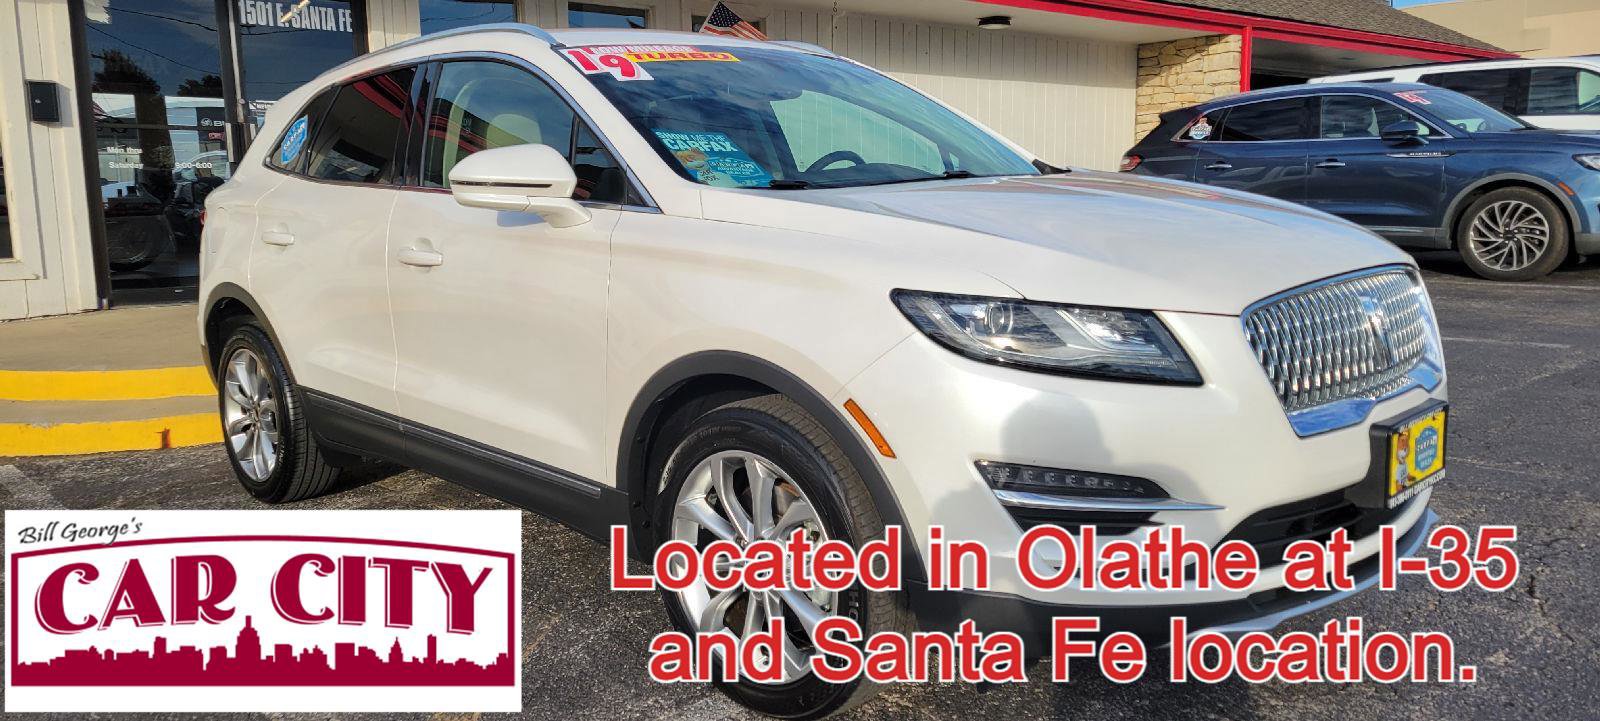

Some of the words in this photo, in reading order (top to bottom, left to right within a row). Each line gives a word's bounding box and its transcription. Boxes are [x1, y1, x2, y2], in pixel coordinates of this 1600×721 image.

[239, 0, 274, 26] 1501
[291, 4, 337, 31] SANTA
[338, 9, 353, 32] FE
[629, 52, 731, 61] TURBO
[567, 50, 636, 77] 19
[655, 132, 690, 141] SHOW
[662, 139, 738, 151] CARFAX
[109, 161, 144, 170] Saturday
